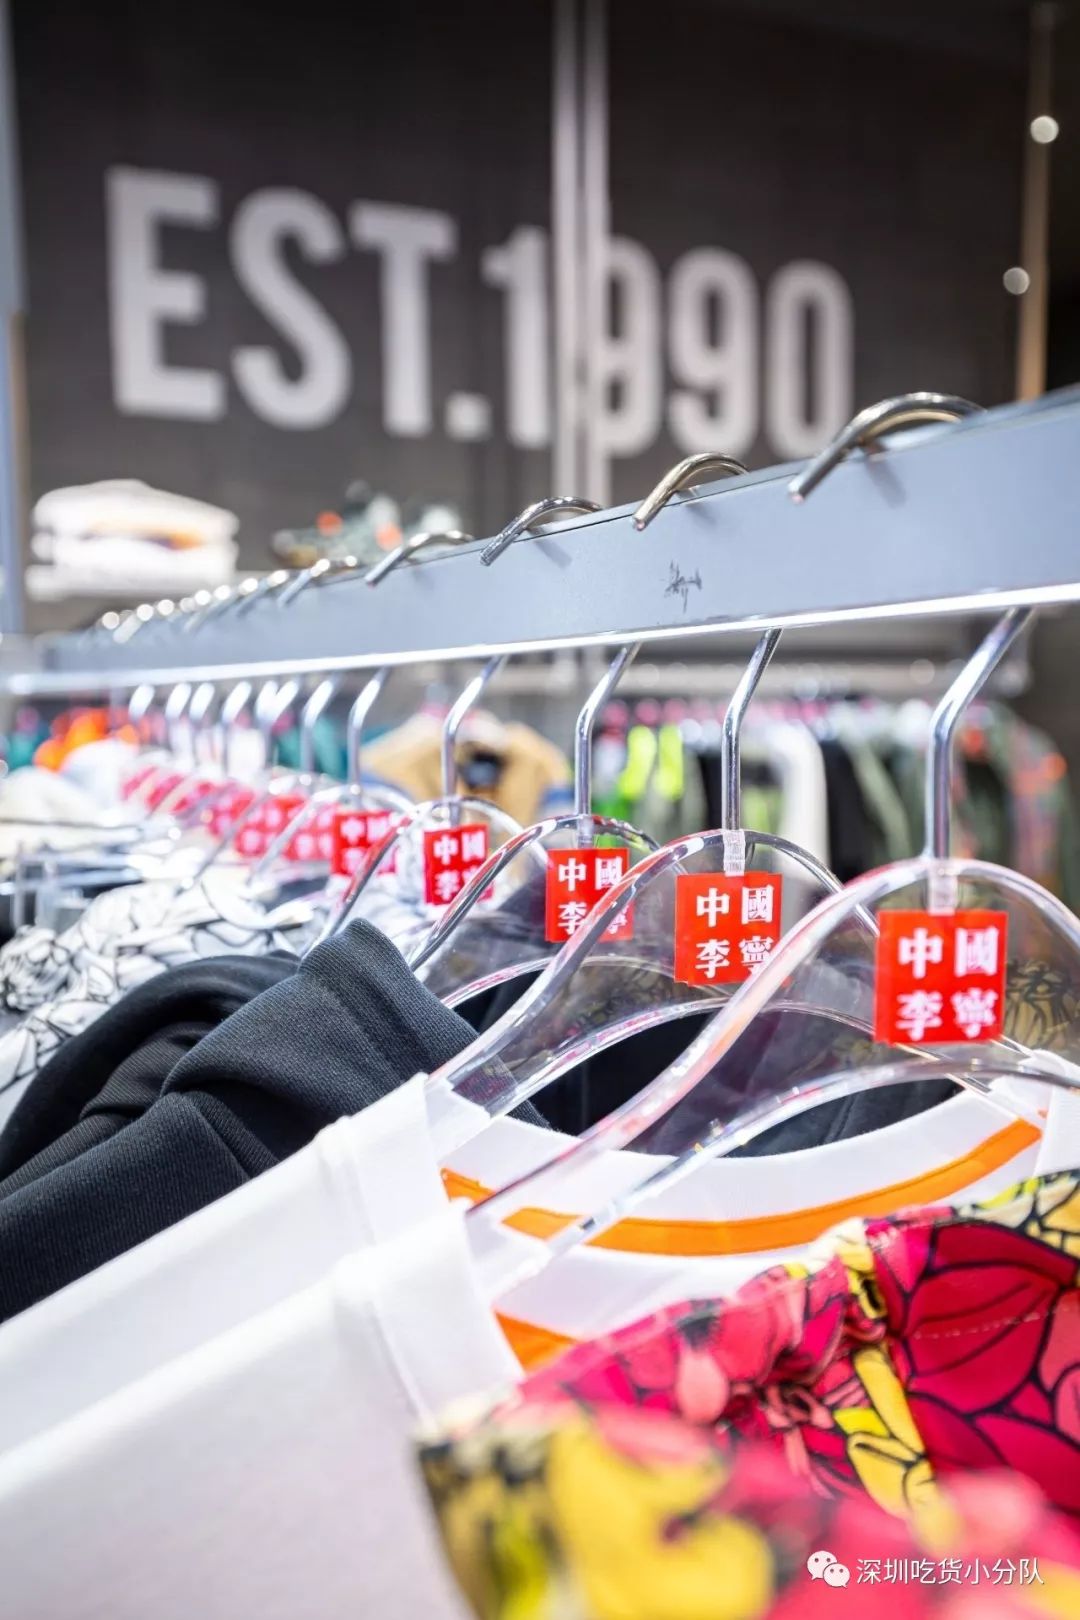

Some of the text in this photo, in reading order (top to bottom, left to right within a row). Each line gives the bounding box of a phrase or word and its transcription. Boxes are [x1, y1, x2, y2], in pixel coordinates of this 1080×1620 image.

[558, 856, 622, 892] 中國
[696, 885, 774, 927] 中國
[898, 927, 999, 979] 中國
[895, 988, 998, 1041] 李寧
